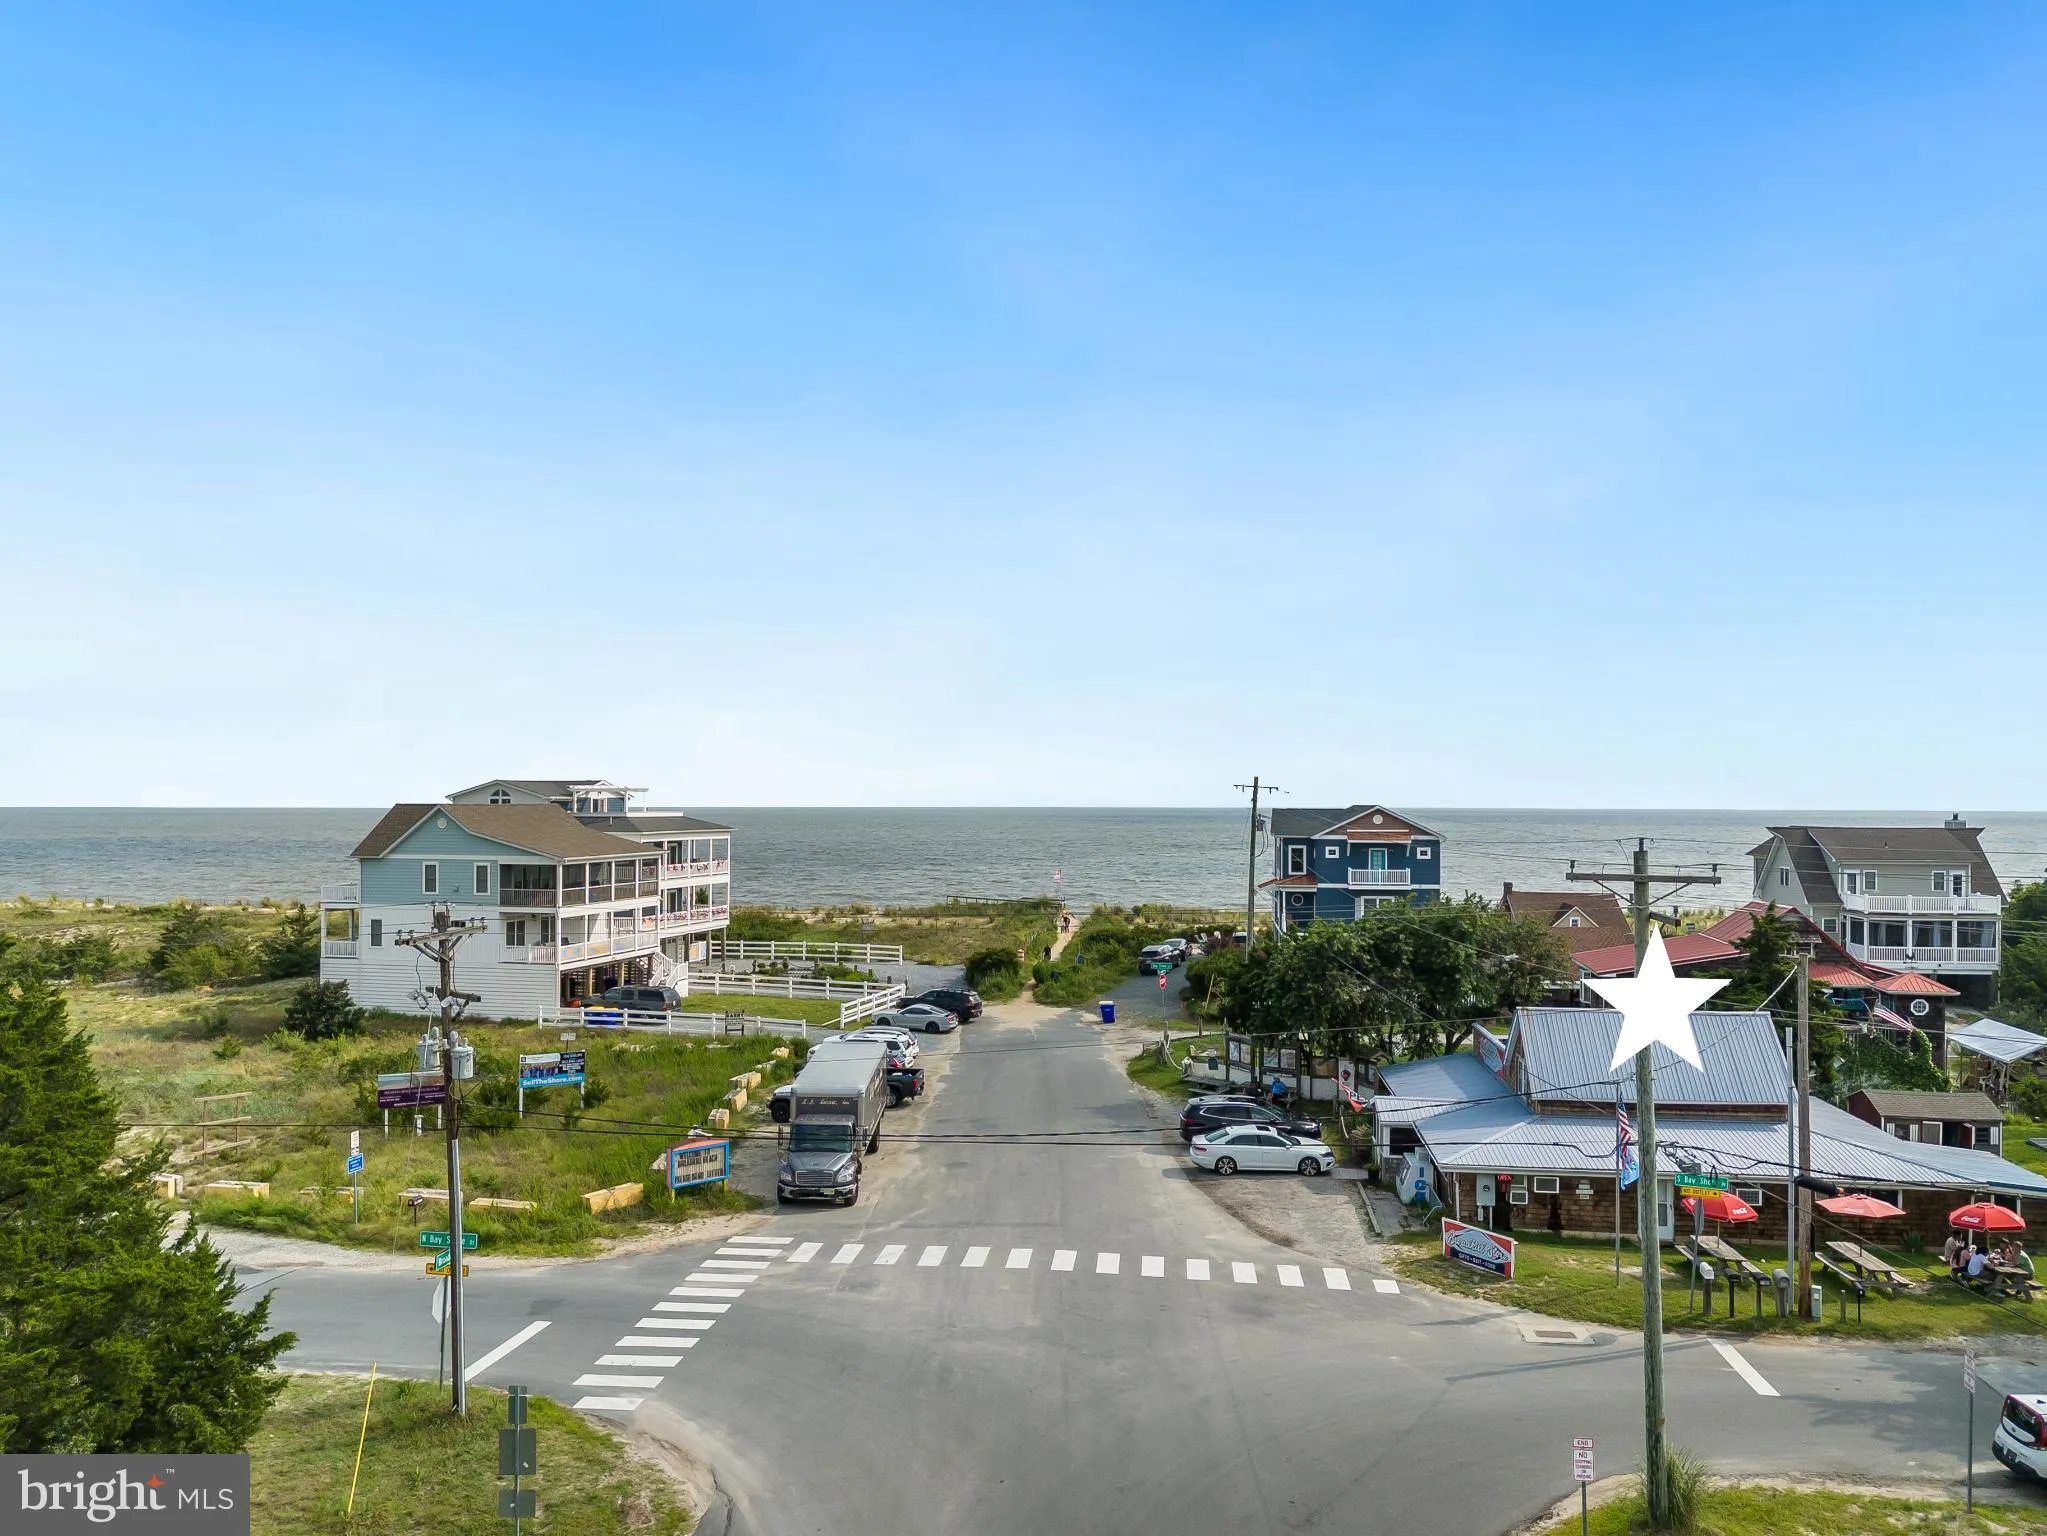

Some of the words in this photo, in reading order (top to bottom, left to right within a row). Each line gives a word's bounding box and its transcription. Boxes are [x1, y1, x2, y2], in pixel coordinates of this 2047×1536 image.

[523, 1076, 583, 1086] SellTheShore.com
[1684, 1175, 1696, 1185] Bay
[421, 1234, 427, 1243] N
[429, 1234, 443, 1245] Bay
[1487, 1244, 1510, 1262] Store
[1458, 1252, 1470, 1261] GIFTS
[1472, 1257, 1482, 1265] BAIT
[1484, 1260, 1496, 1269] FOOD
[1578, 1451, 1588, 1459] NO
